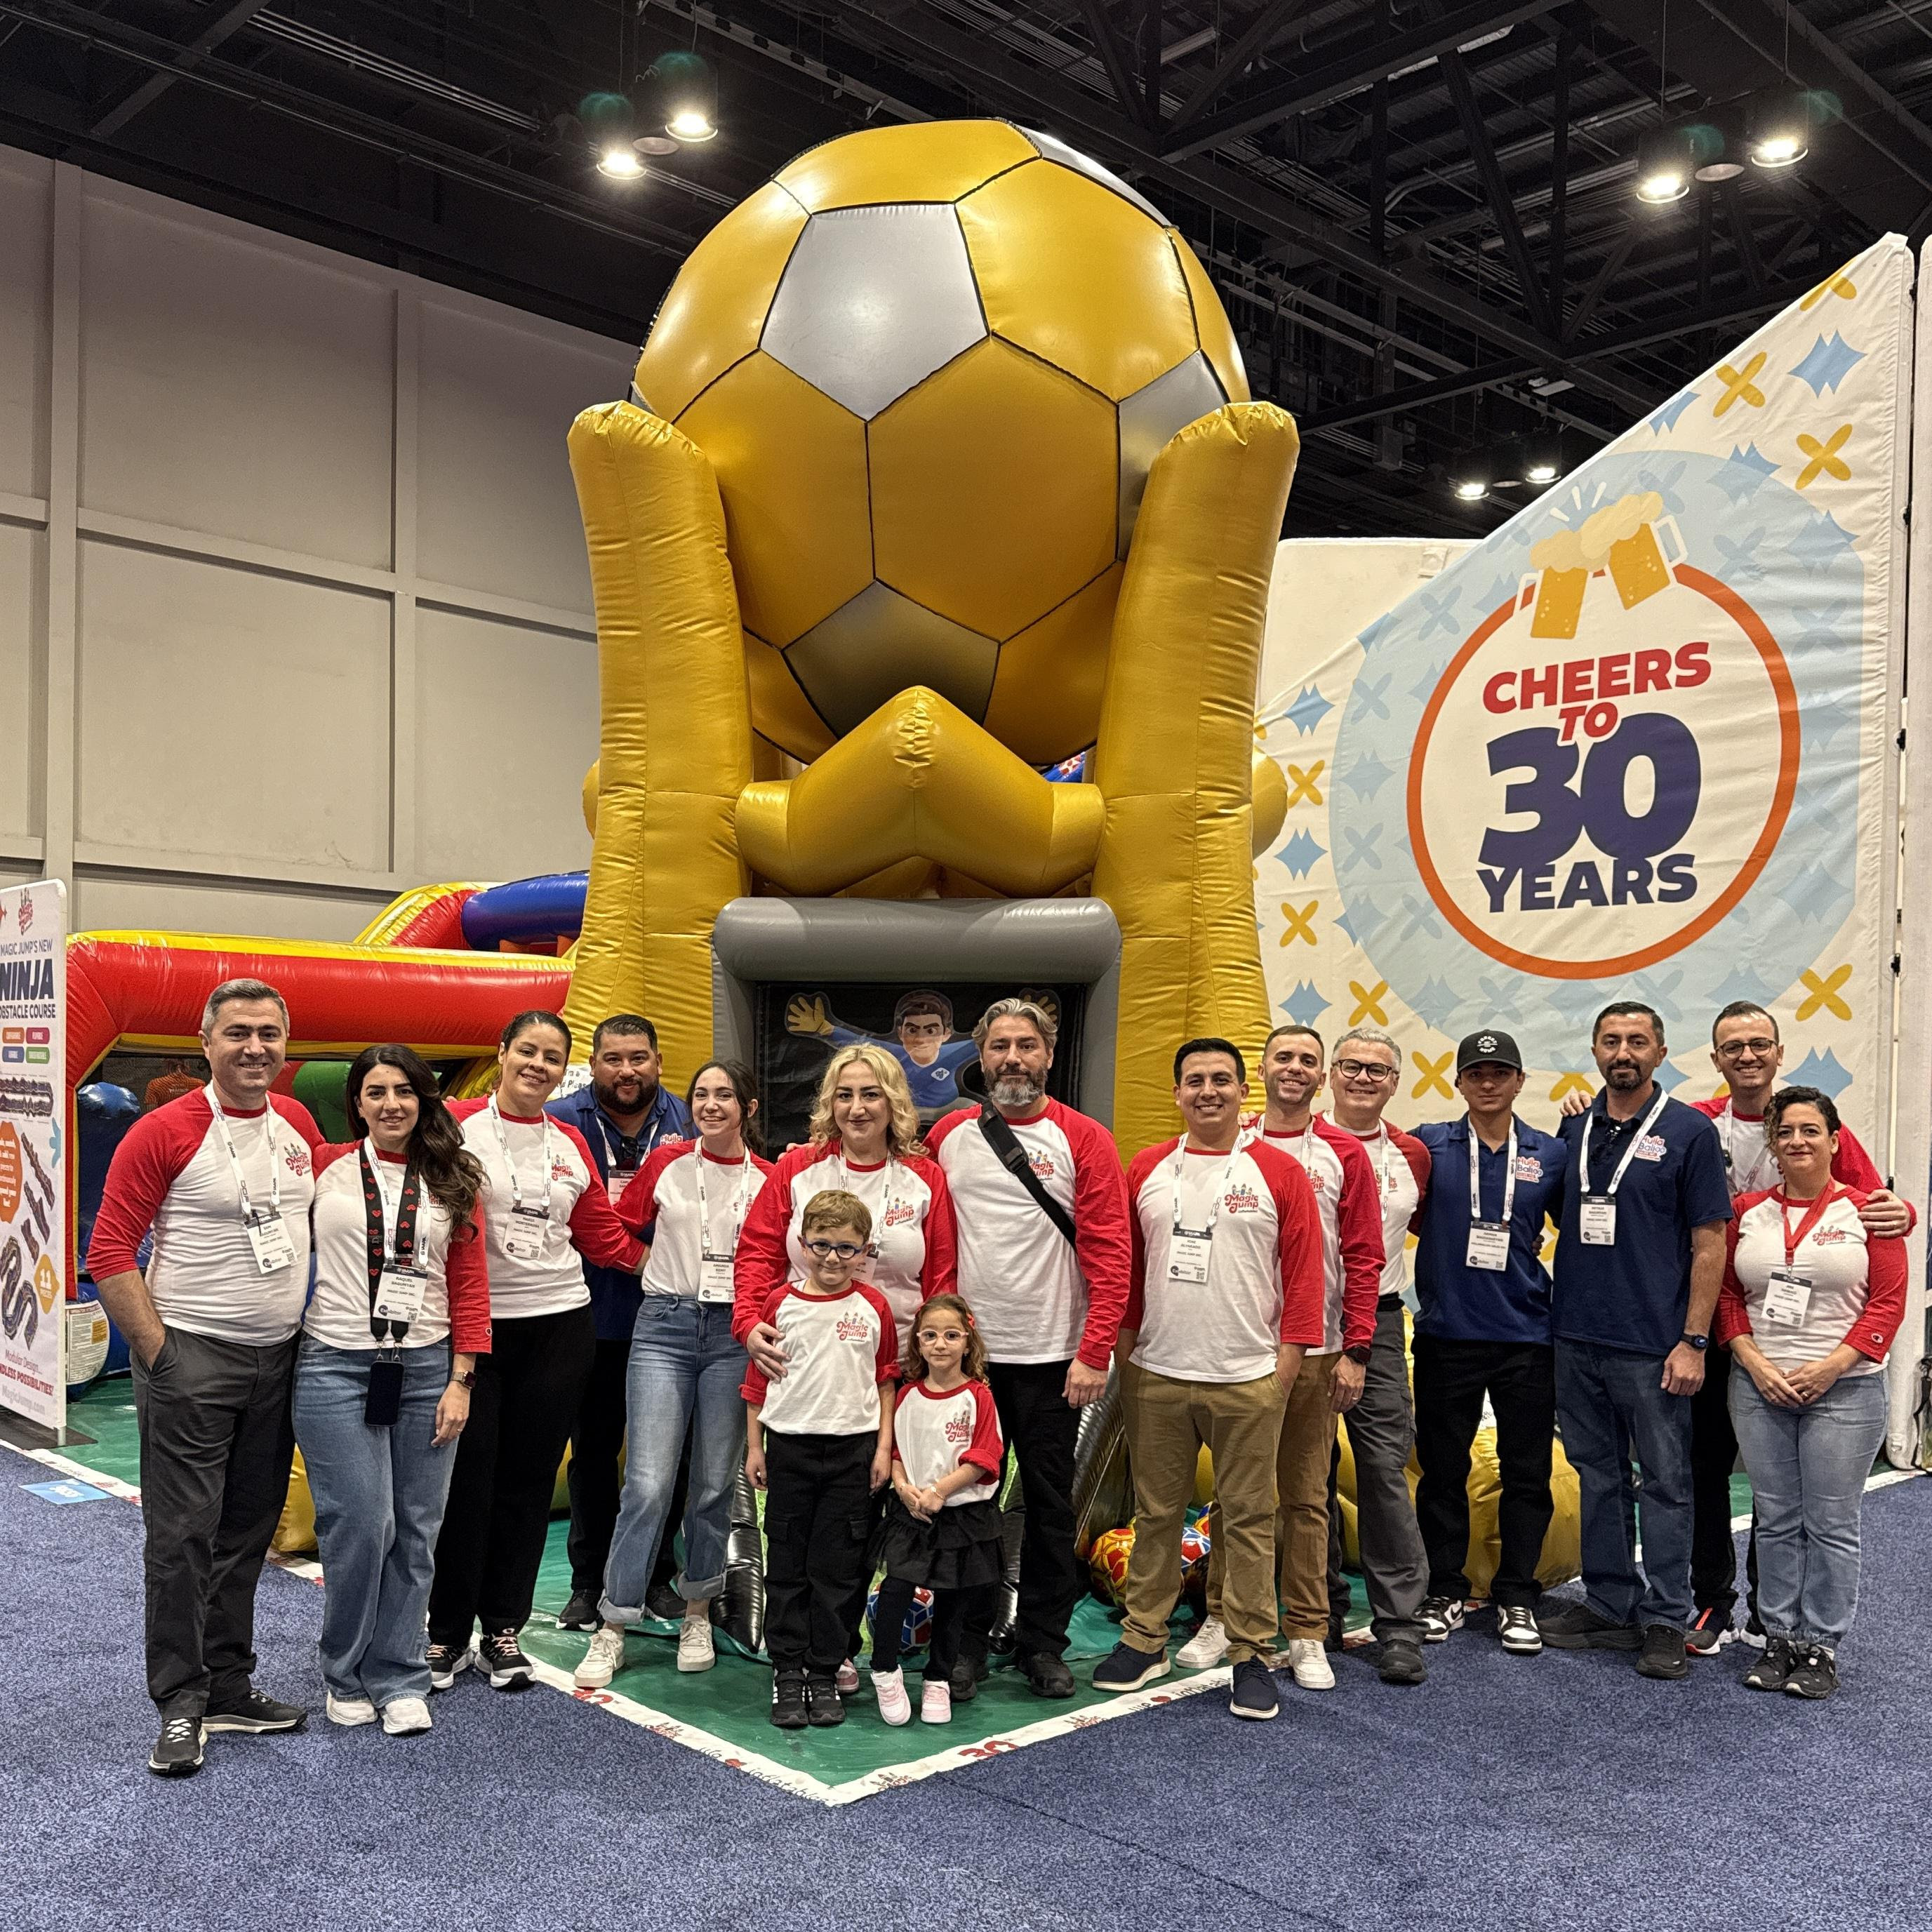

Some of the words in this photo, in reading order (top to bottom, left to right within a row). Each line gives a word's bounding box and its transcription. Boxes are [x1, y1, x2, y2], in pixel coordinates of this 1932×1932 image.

[1482, 641, 1712, 714] CHEERS
[1558, 702, 1619, 742] TO
[1478, 712, 1702, 869] 30
[1476, 853, 1698, 913] YEARS
[1, 942, 17, 956] MAGIC
[18, 940, 38, 954] JUMP'S
[39, 938, 53, 952] NEW
[0, 959, 54, 1001] NINJA
[29, 1004, 55, 1019] COURSE
[1225, 1194, 1259, 1206] Magic
[1229, 1201, 1259, 1213] Jump
[40, 1268, 52, 1289] 11
[836, 1321, 869, 1333] Magic
[839, 1330, 867, 1341] Jump
